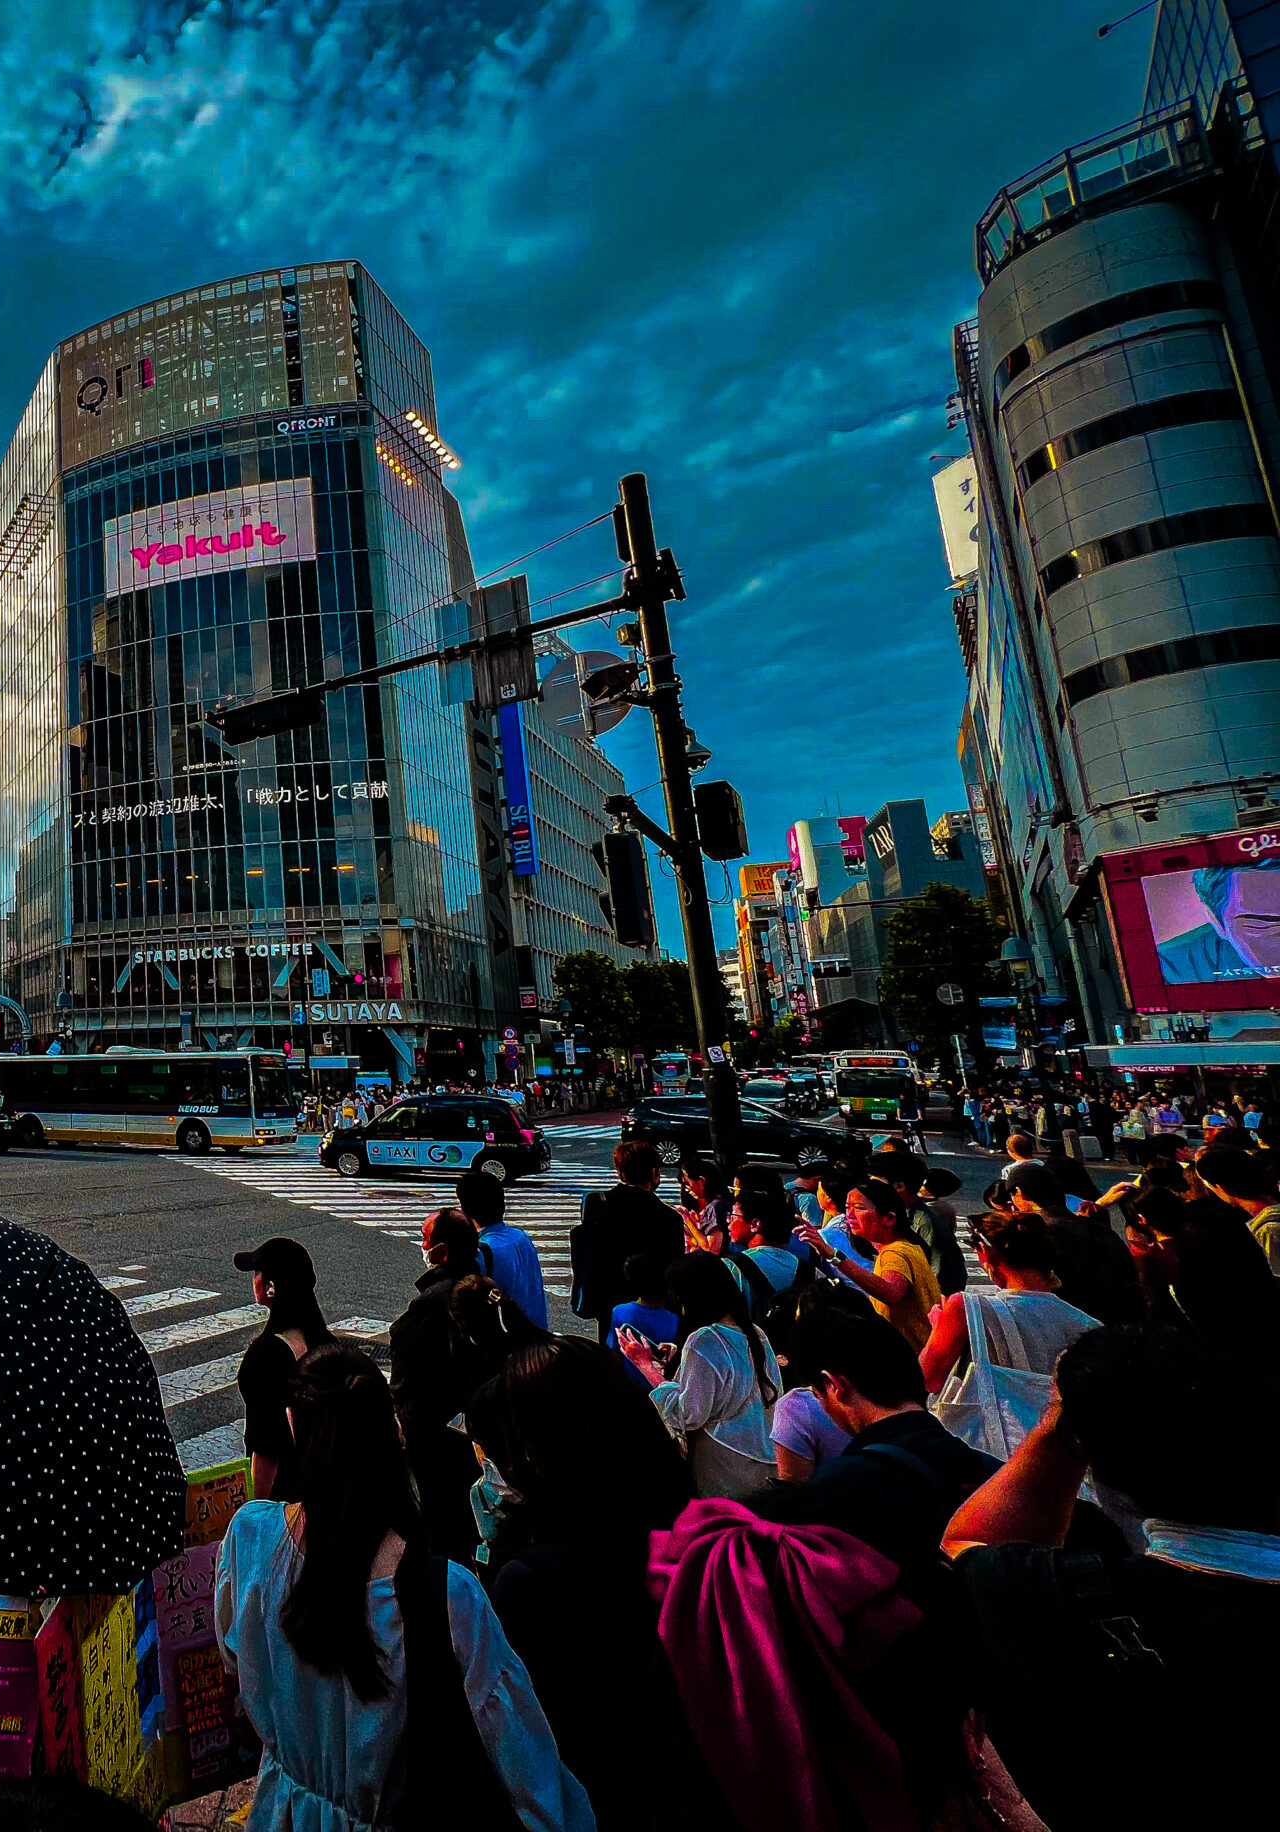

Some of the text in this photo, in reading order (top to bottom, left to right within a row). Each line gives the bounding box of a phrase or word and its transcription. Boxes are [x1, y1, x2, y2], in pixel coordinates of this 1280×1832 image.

[277, 415, 336, 434] QFRONT
[129, 521, 287, 570] Yakult
[246, 781, 390, 805] 「戦力として貢献
[73, 794, 226, 828] ズと契約の渡辺雄太、
[509, 804, 533, 865] SEIBU
[134, 942, 313, 963] STARBUCKS COFFEE
[178, 1105, 219, 1113] KEIO BUS
[385, 1144, 463, 1164] TAXI GO
